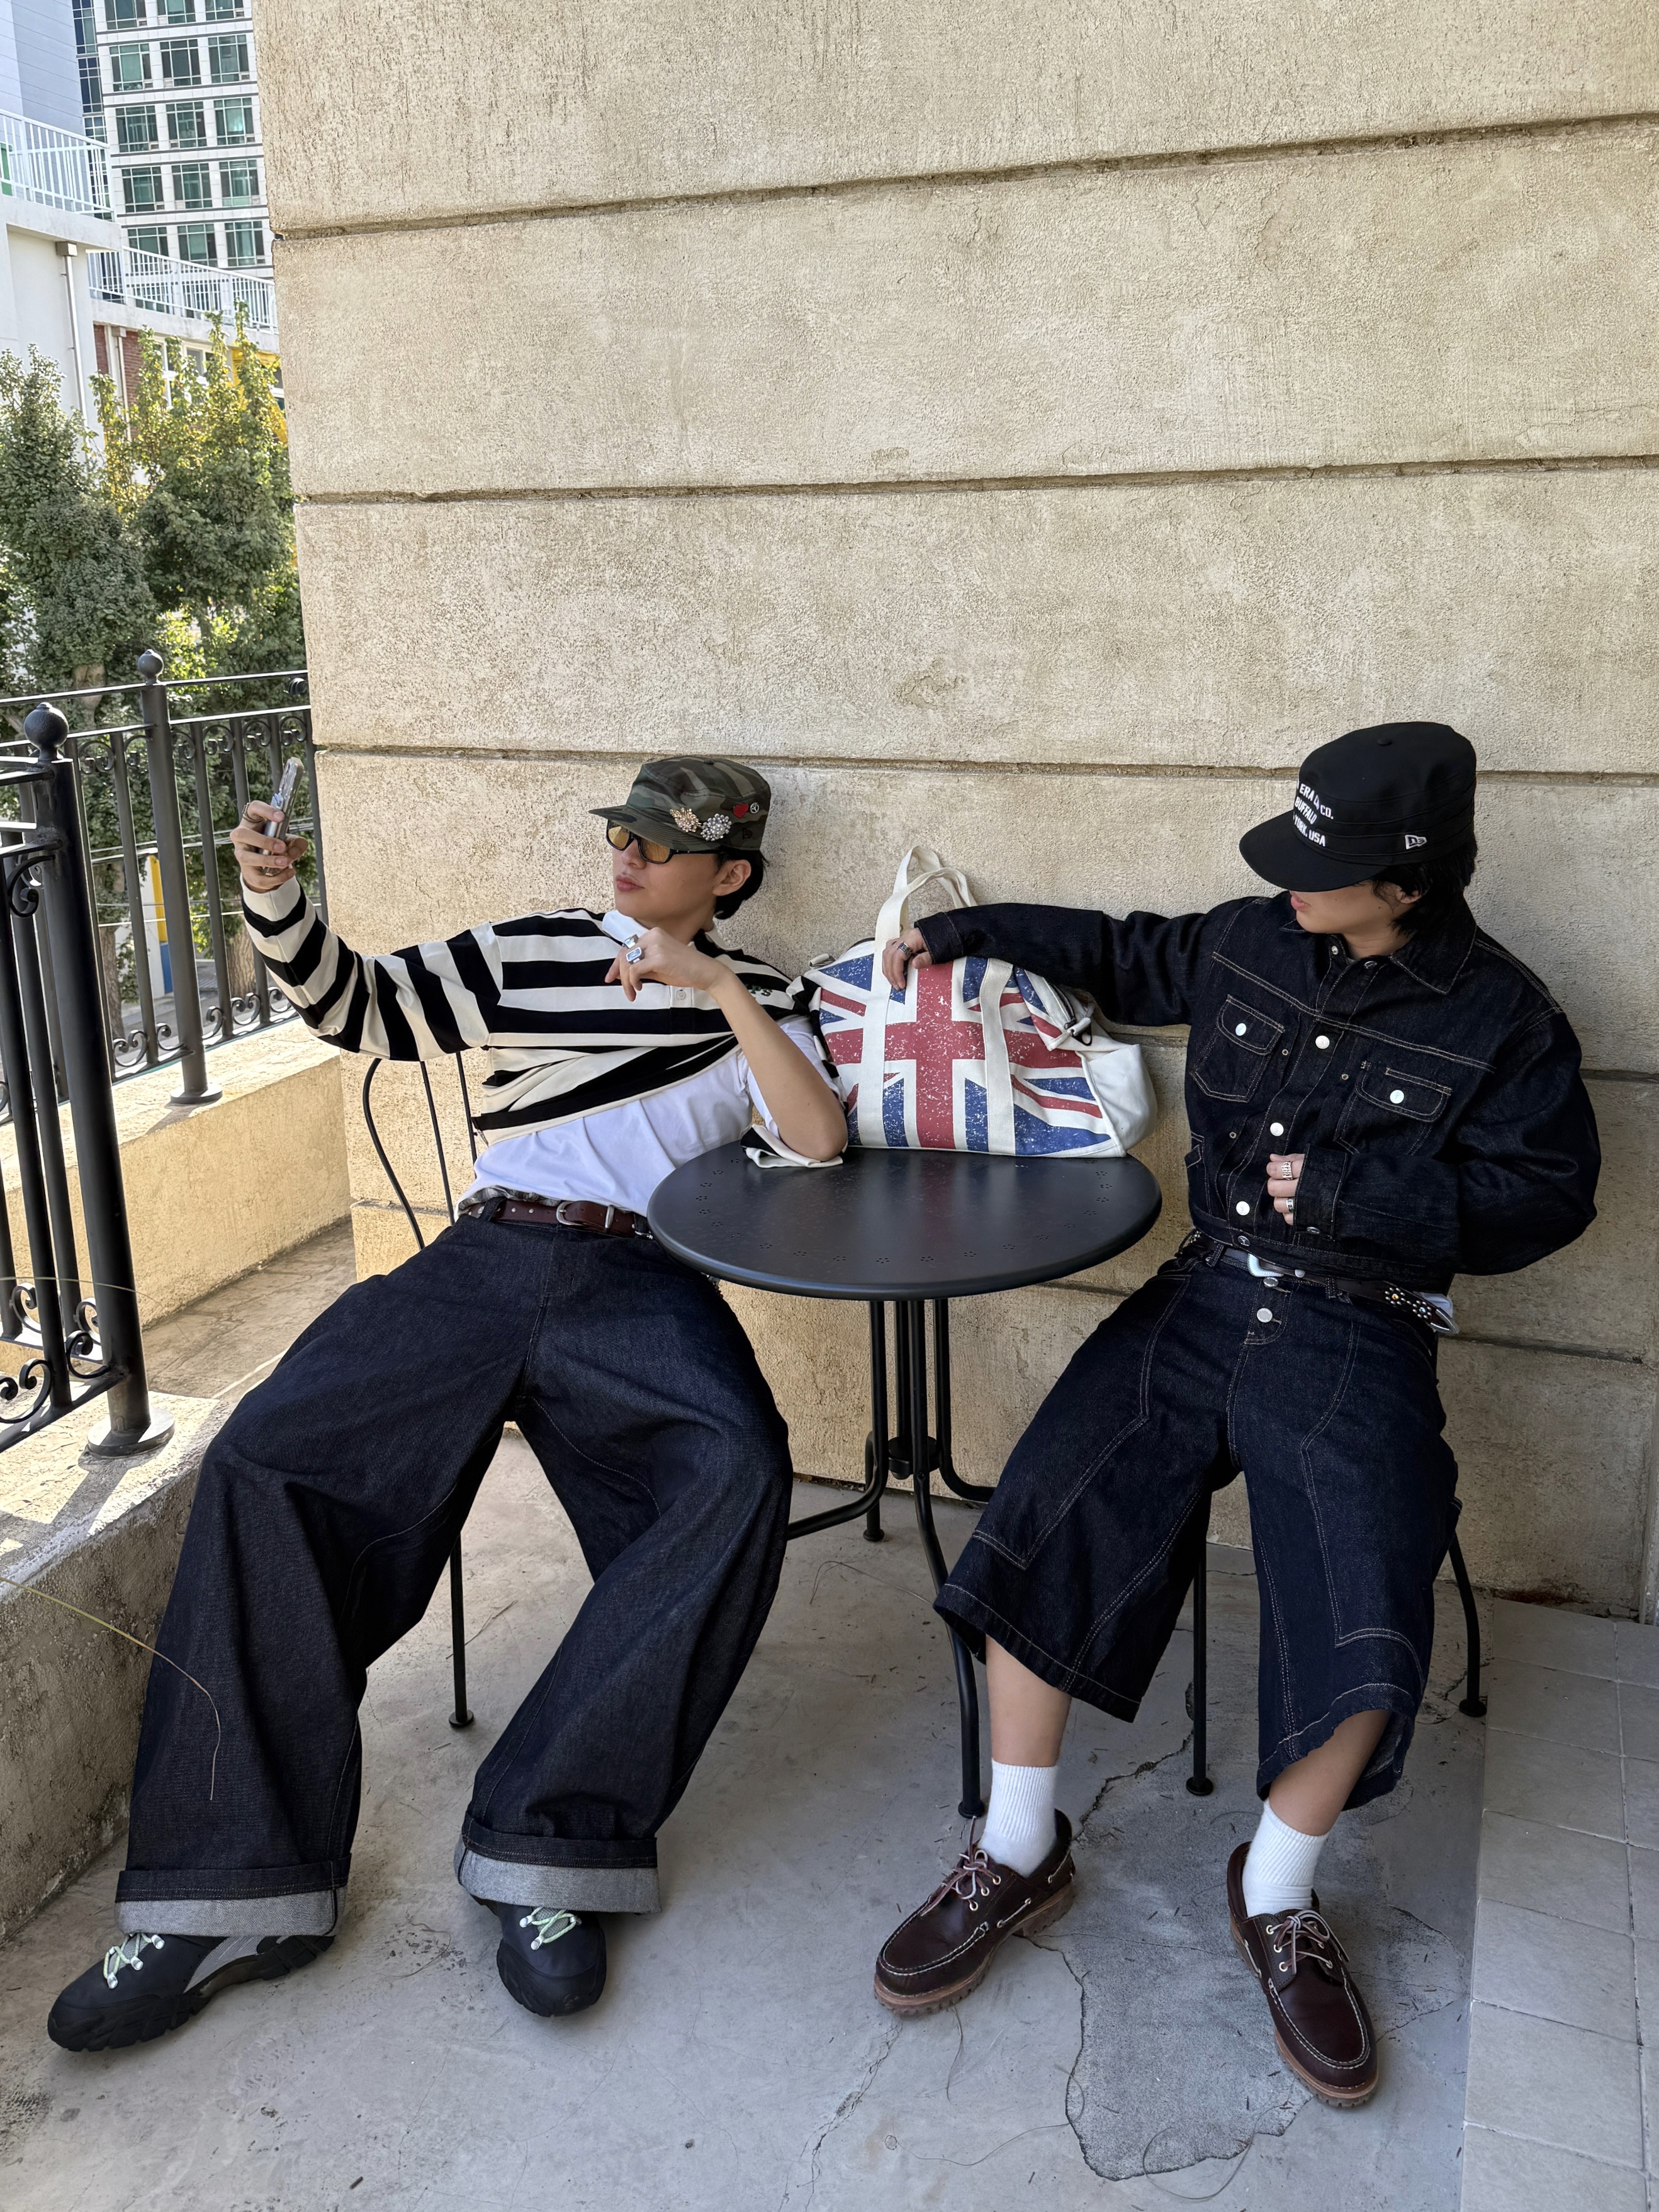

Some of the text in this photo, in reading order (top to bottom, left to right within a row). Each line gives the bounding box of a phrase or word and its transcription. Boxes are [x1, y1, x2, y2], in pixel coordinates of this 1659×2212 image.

[1295, 796, 1317, 825] BUFFALO
[1299, 783, 1315, 801] ERA
[1320, 804, 1334, 820] CO.
[1308, 830, 1325, 847] USA
